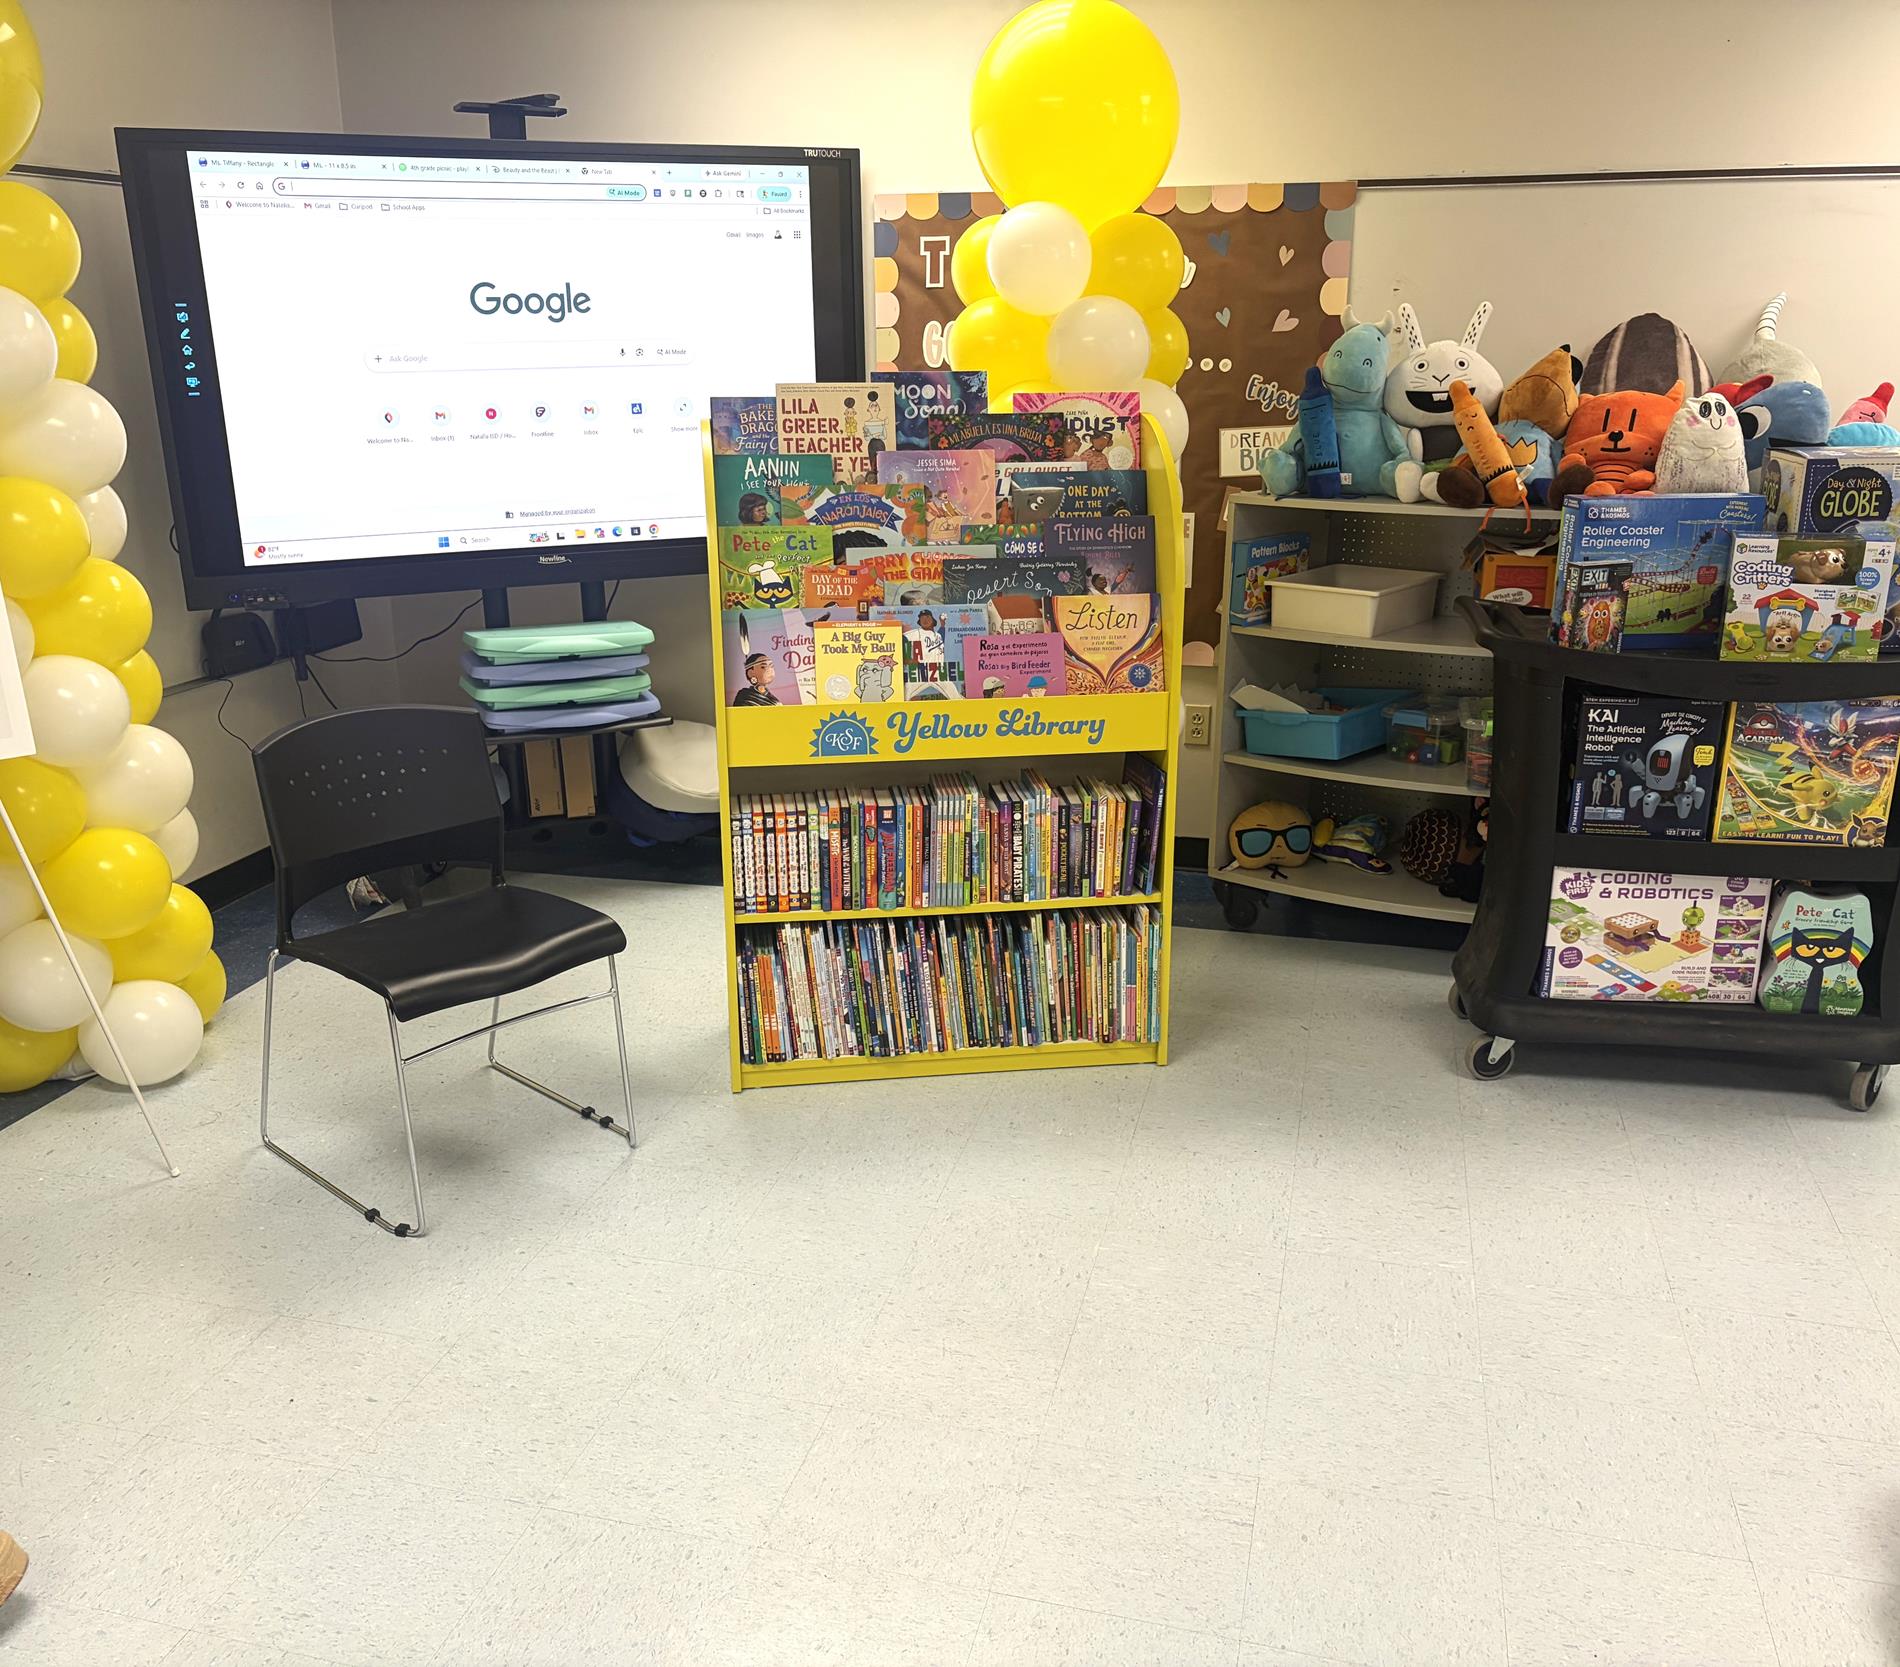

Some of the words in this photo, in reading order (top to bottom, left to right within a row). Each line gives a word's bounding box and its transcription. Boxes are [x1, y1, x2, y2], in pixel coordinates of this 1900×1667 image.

[803, 148, 841, 158] TRUTOUCH
[247, 160, 274, 168] Rectangle
[469, 281, 592, 323] Google
[388, 354, 402, 363] Ask
[403, 354, 428, 364] Google
[894, 384, 951, 400] MOON
[1246, 374, 1300, 420] Enjoy
[781, 398, 819, 415] LILA
[782, 417, 844, 435] GREER,
[960, 424, 990, 440] ABUELA
[992, 423, 1001, 435] ES
[1001, 424, 1018, 437] UNA
[735, 436, 767, 455] Fairy
[783, 436, 863, 454] TEACHER
[1230, 432, 1287, 449] DREAM
[744, 456, 800, 481] AANIIN
[917, 459, 939, 467] JESSIE
[939, 458, 957, 467] SIMA
[746, 480, 760, 490] SEE
[763, 479, 782, 487] YOUR
[1068, 485, 1089, 497] ONE
[1091, 486, 1110, 496] DAY
[1827, 478, 1845, 491] Day
[1846, 478, 1857, 488] &
[1857, 478, 1882, 490] Night
[839, 494, 852, 503] EN
[854, 494, 870, 503] LOS
[1074, 500, 1084, 508] AT
[1087, 500, 1102, 508] THE
[1820, 490, 1883, 518] GLOBE
[1719, 509, 1758, 521] Coasters!
[1568, 514, 1576, 543] Roller
[1582, 526, 1617, 536] Roller
[1619, 525, 1665, 536] Coaster
[732, 534, 771, 552] Pete
[772, 535, 785, 544] the
[785, 534, 818, 551] Cat
[1004, 541, 1026, 554] CÓMO
[1027, 542, 1038, 554] SE
[1558, 513, 1570, 571] Engineering
[1581, 537, 1651, 549] Engineering
[1251, 545, 1277, 559] Pattern
[1278, 540, 1301, 553] Blocks
[1879, 548, 1892, 557] 4+
[1734, 560, 1794, 576] Coding
[811, 575, 832, 584] DAY
[844, 576, 858, 584] THE
[1570, 568, 1578, 591] EXIT
[1584, 569, 1608, 583] EXIT
[1733, 573, 1793, 587] Critters
[1859, 571, 1878, 579] 100%
[816, 584, 853, 596] DEAD
[967, 571, 1019, 605] Desert
[1065, 602, 1138, 631] Listen
[831, 632, 841, 641] A
[843, 631, 862, 643] Big
[864, 631, 886, 643] Guy
[821, 644, 849, 655] Took
[852, 644, 868, 655] My
[871, 643, 896, 653] Ball!
[980, 639, 999, 651] Rosa
[1011, 661, 1028, 670] Bird
[1028, 661, 1051, 669] Feeder
[1587, 708, 1620, 723] KAI
[1587, 724, 1605, 733] The
[1607, 725, 1646, 734] Artificial
[1660, 717, 1693, 730] Machine
[886, 711, 988, 753] Yellow
[995, 708, 1106, 745] Library
[1666, 726, 1705, 736] Learning!
[1586, 734, 1642, 744] Intelligence
[1736, 733, 1785, 744] ACADEMY
[1584, 743, 1614, 752] Robot
[1571, 807, 1579, 827] THAMES
[1816, 834, 1839, 842] PLAY!
[1013, 835, 1023, 856] BABY
[1013, 857, 1023, 889] PIRATES
[1600, 872, 1673, 885] CODING
[1565, 878, 1591, 889] KIDS
[1566, 887, 1592, 898] FIRST
[1599, 887, 1612, 899] &
[1617, 887, 1714, 900] ROBOTICS
[1796, 904, 1823, 917] Pete
[1832, 908, 1855, 919] Cat
[919, 927, 928, 961] EYEWITNESS
[925, 981, 933, 1009] PLANETAS
